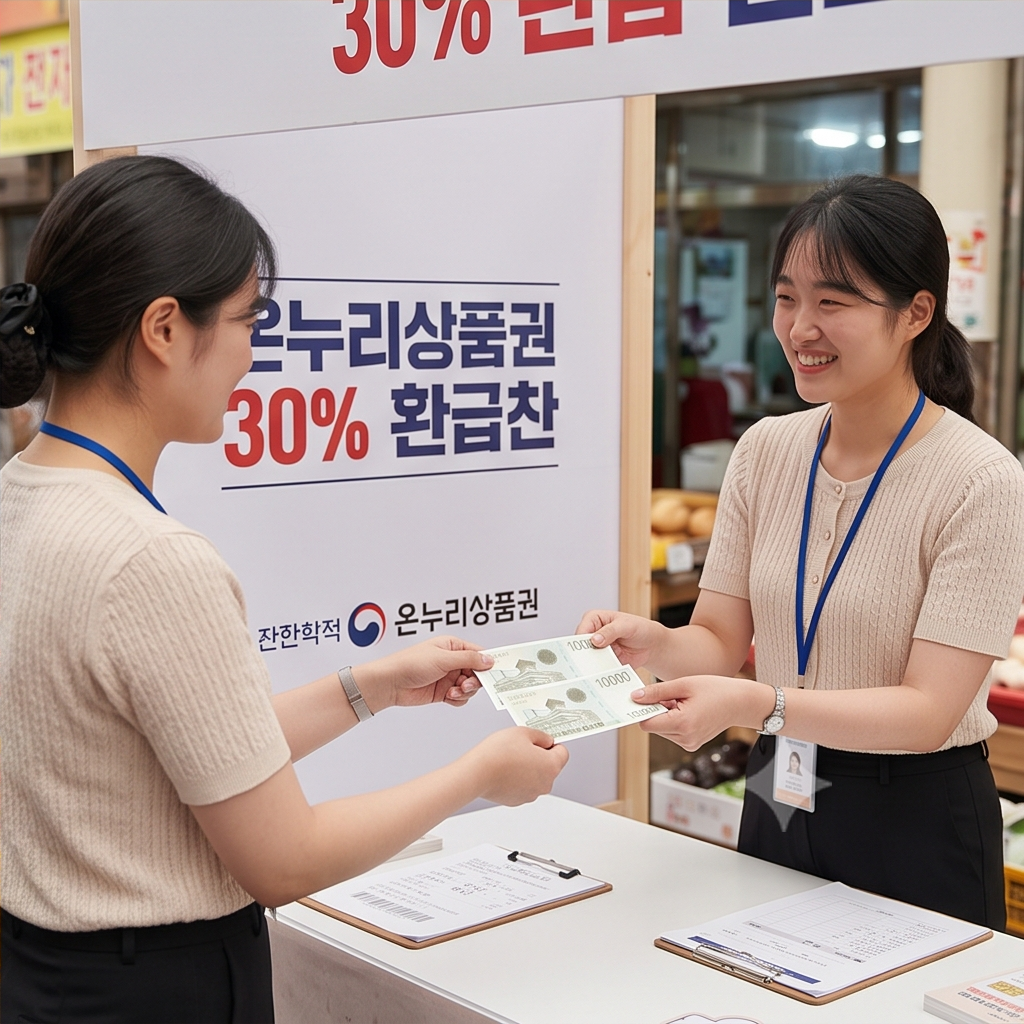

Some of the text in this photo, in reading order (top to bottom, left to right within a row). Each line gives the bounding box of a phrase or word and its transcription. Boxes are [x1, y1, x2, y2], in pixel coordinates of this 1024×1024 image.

[331, 0, 491, 74] 30%
[248, 298, 557, 373] 온누리상품권
[223, 380, 560, 468] 30% 환급찬
[394, 587, 539, 638] 온누리상품권
[595, 670, 632, 689] 10000
